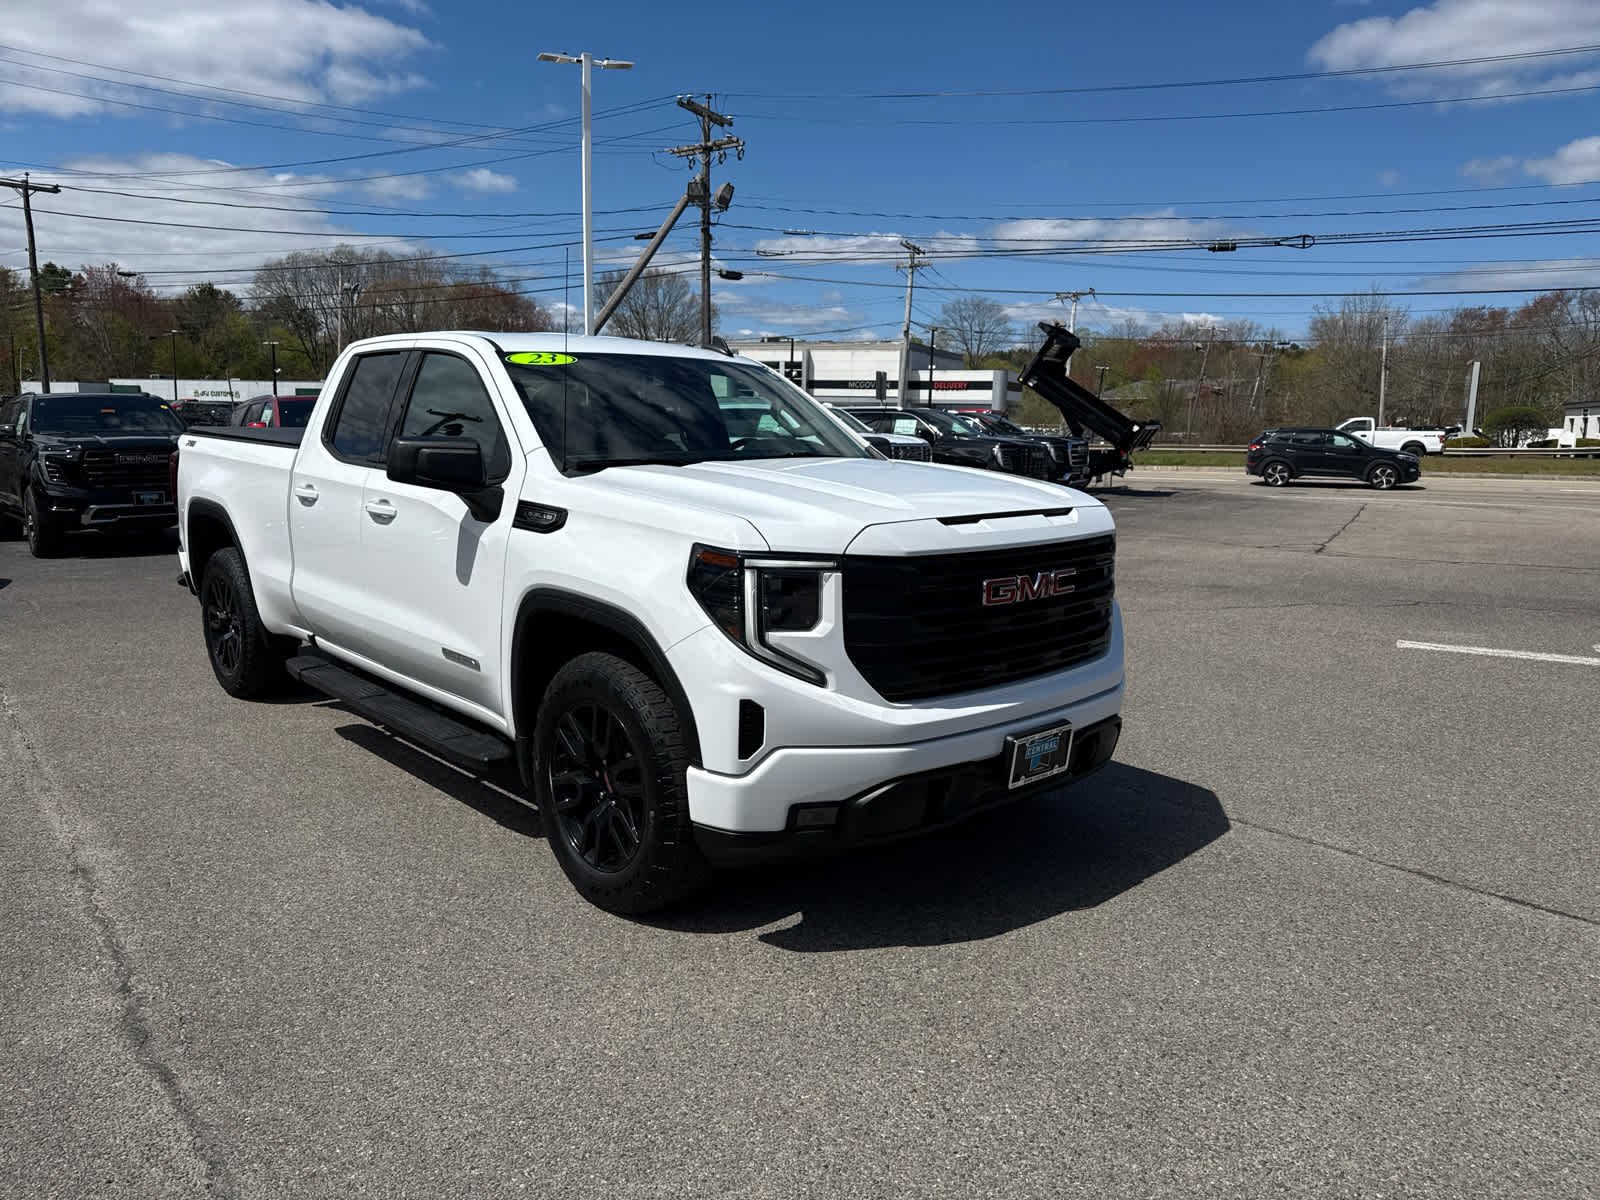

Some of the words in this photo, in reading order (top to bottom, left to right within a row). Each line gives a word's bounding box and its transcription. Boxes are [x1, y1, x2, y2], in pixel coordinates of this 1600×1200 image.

[527, 353, 557, 364] 23
[848, 381, 890, 389] MCGOVN
[982, 568, 1077, 606] GMC
[1027, 739, 1057, 756] CENTRAL
